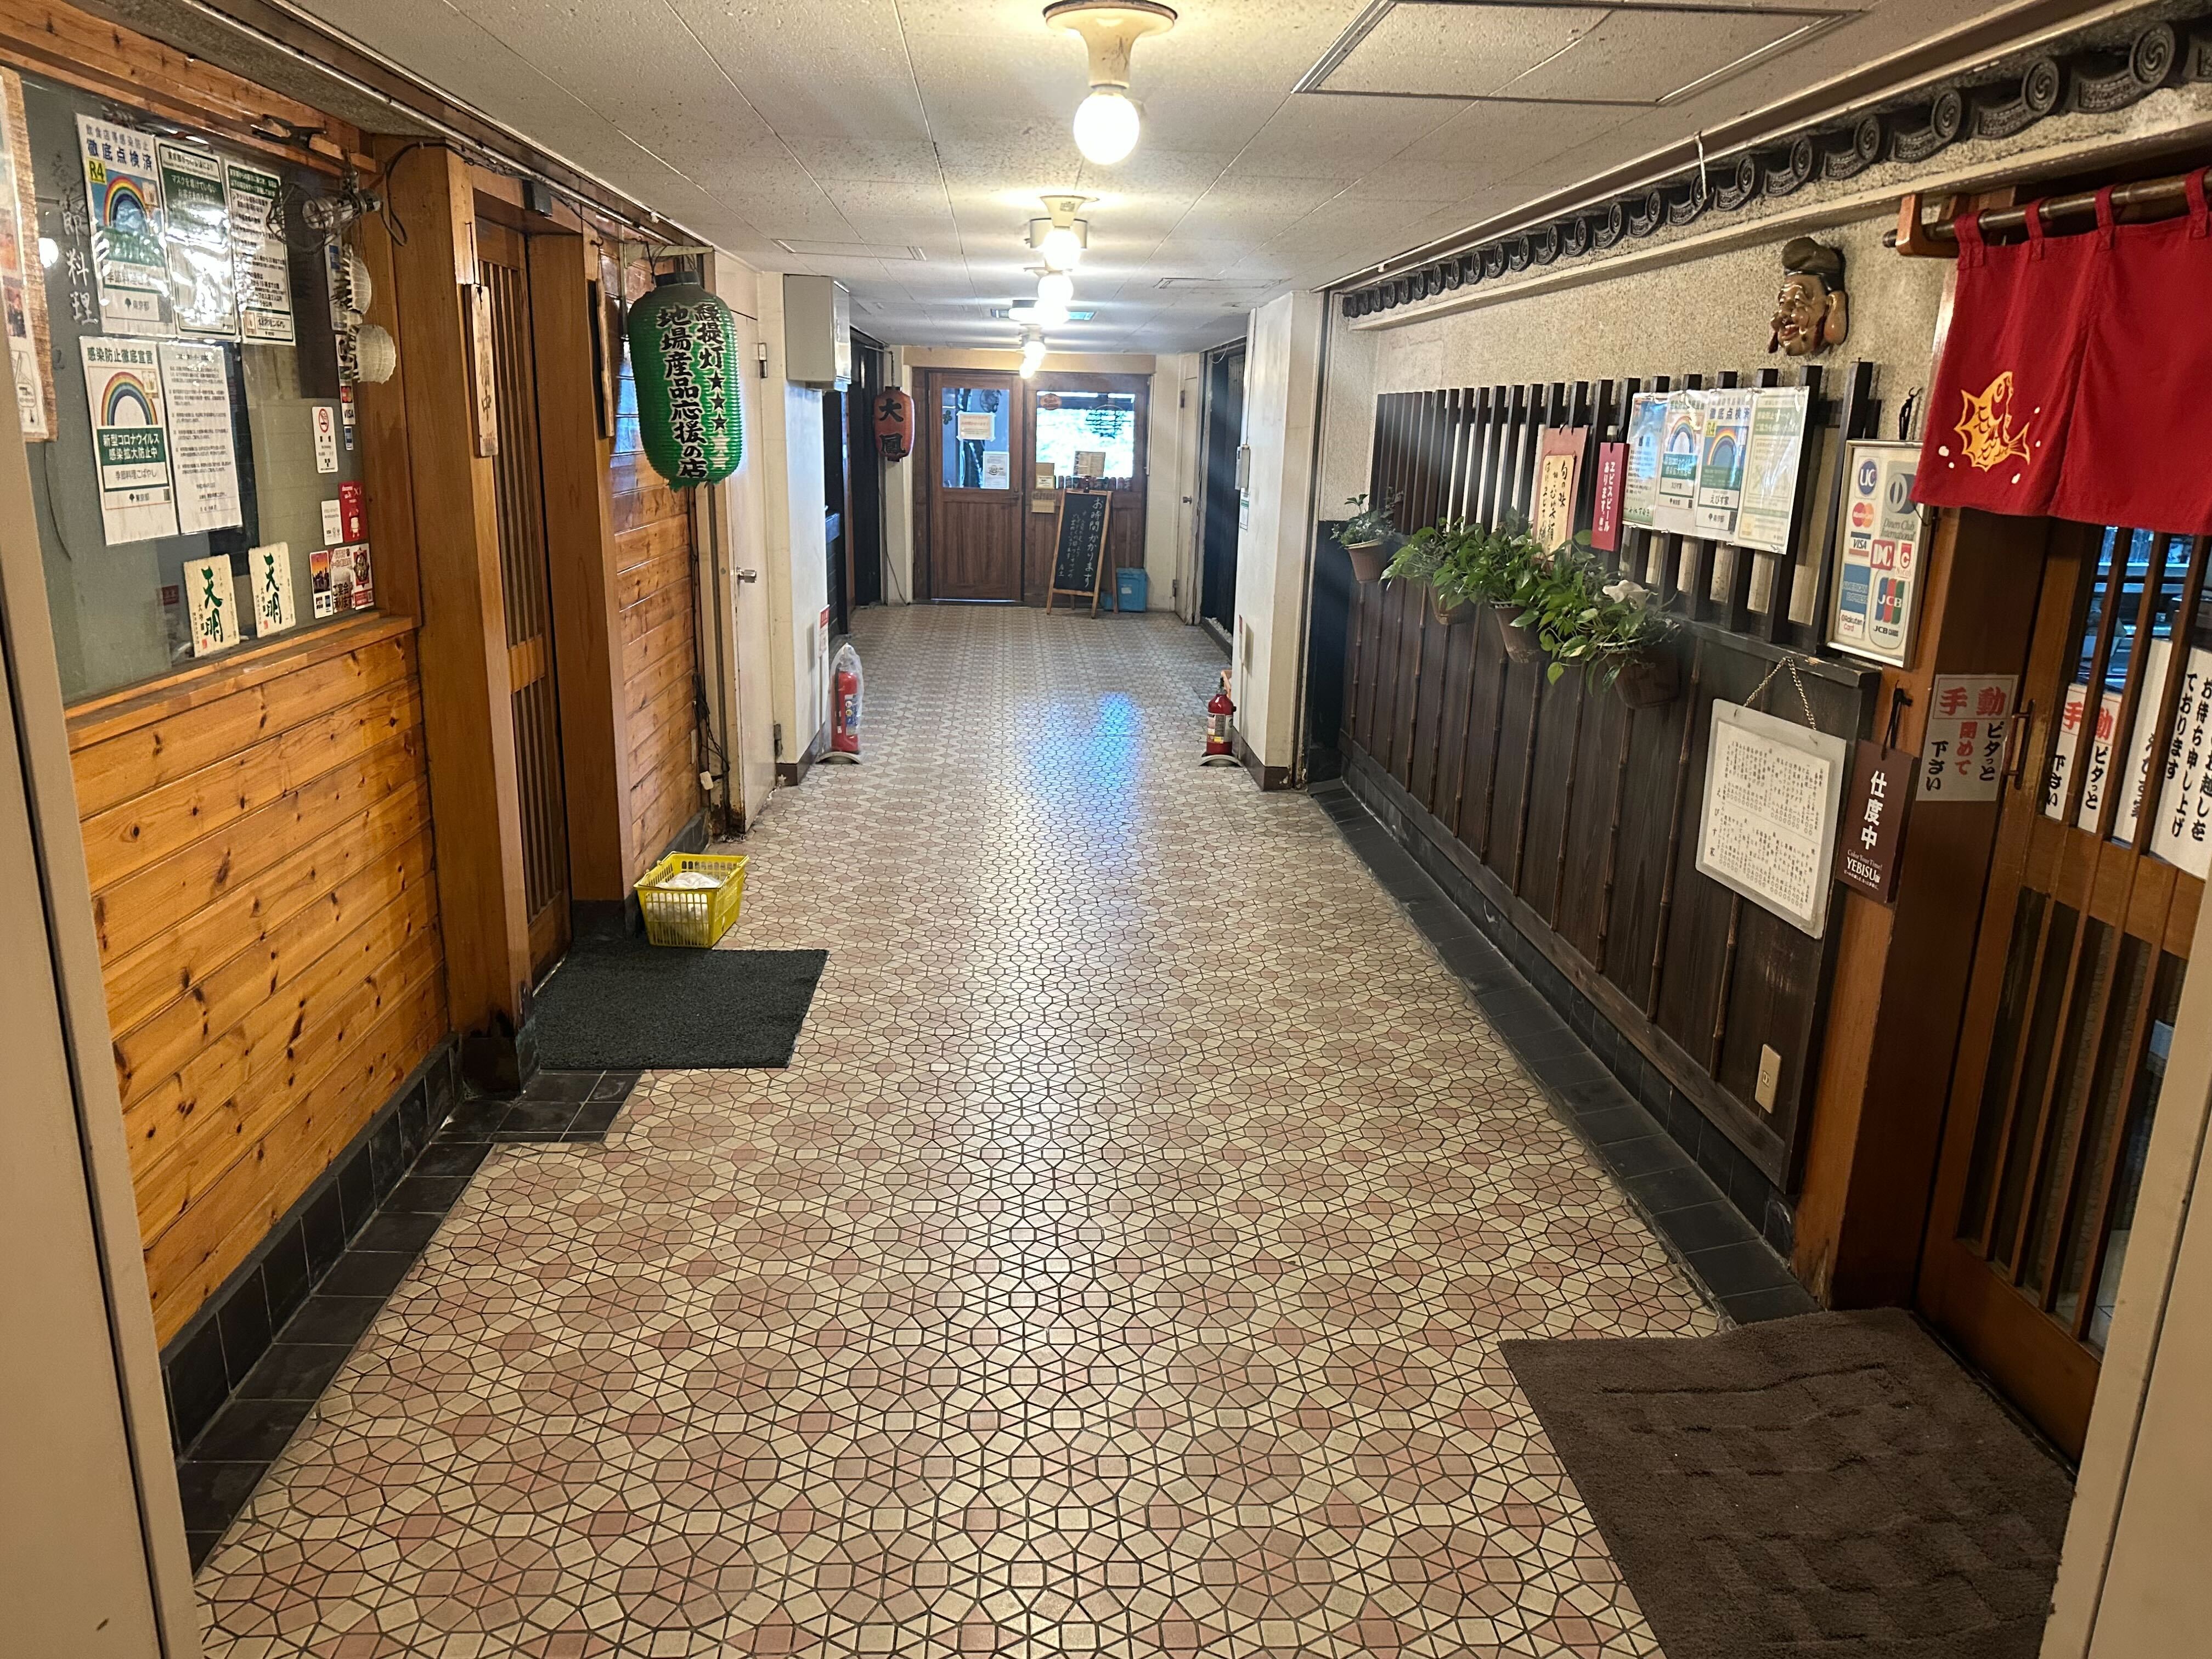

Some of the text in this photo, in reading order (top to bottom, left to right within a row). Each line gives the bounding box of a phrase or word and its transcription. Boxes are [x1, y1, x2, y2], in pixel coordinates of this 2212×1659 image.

[87, 139, 152, 172] 徹底点検済
[89, 160, 104, 180] R4
[87, 347, 153, 364] 感染防止徹底宣言
[658, 304, 708, 478] 地場産品応援の店
[103, 433, 160, 447] 新型コロナウイルス
[109, 447, 158, 461] 感染拡大防止中
[1860, 469, 1876, 487] UC
[1881, 527, 1916, 541] International
[1883, 518, 1915, 529] Diners Club
[1084, 496, 1104, 588] お時間かかります
[1853, 539, 1867, 549] VISA
[1872, 544, 1893, 567] DC
[1878, 595, 1902, 607] JCB
[1844, 623, 1854, 632] Card
[1874, 625, 1888, 634] JCB
[1939, 686, 2006, 716] 手動
[2167, 673, 2198, 780] ております
[1955, 721, 1978, 775] 閉めて
[1979, 721, 2004, 781] ピタっと
[2171, 676, 2212, 837] お待ち申し上げ
[1926, 741, 1949, 791] 下さい
[2085, 746, 2108, 810] ピタっと
[1861, 770, 1887, 850] 仕度中
[1847, 849, 1859, 860] Color
[1847, 856, 1877, 881] YEBISU
